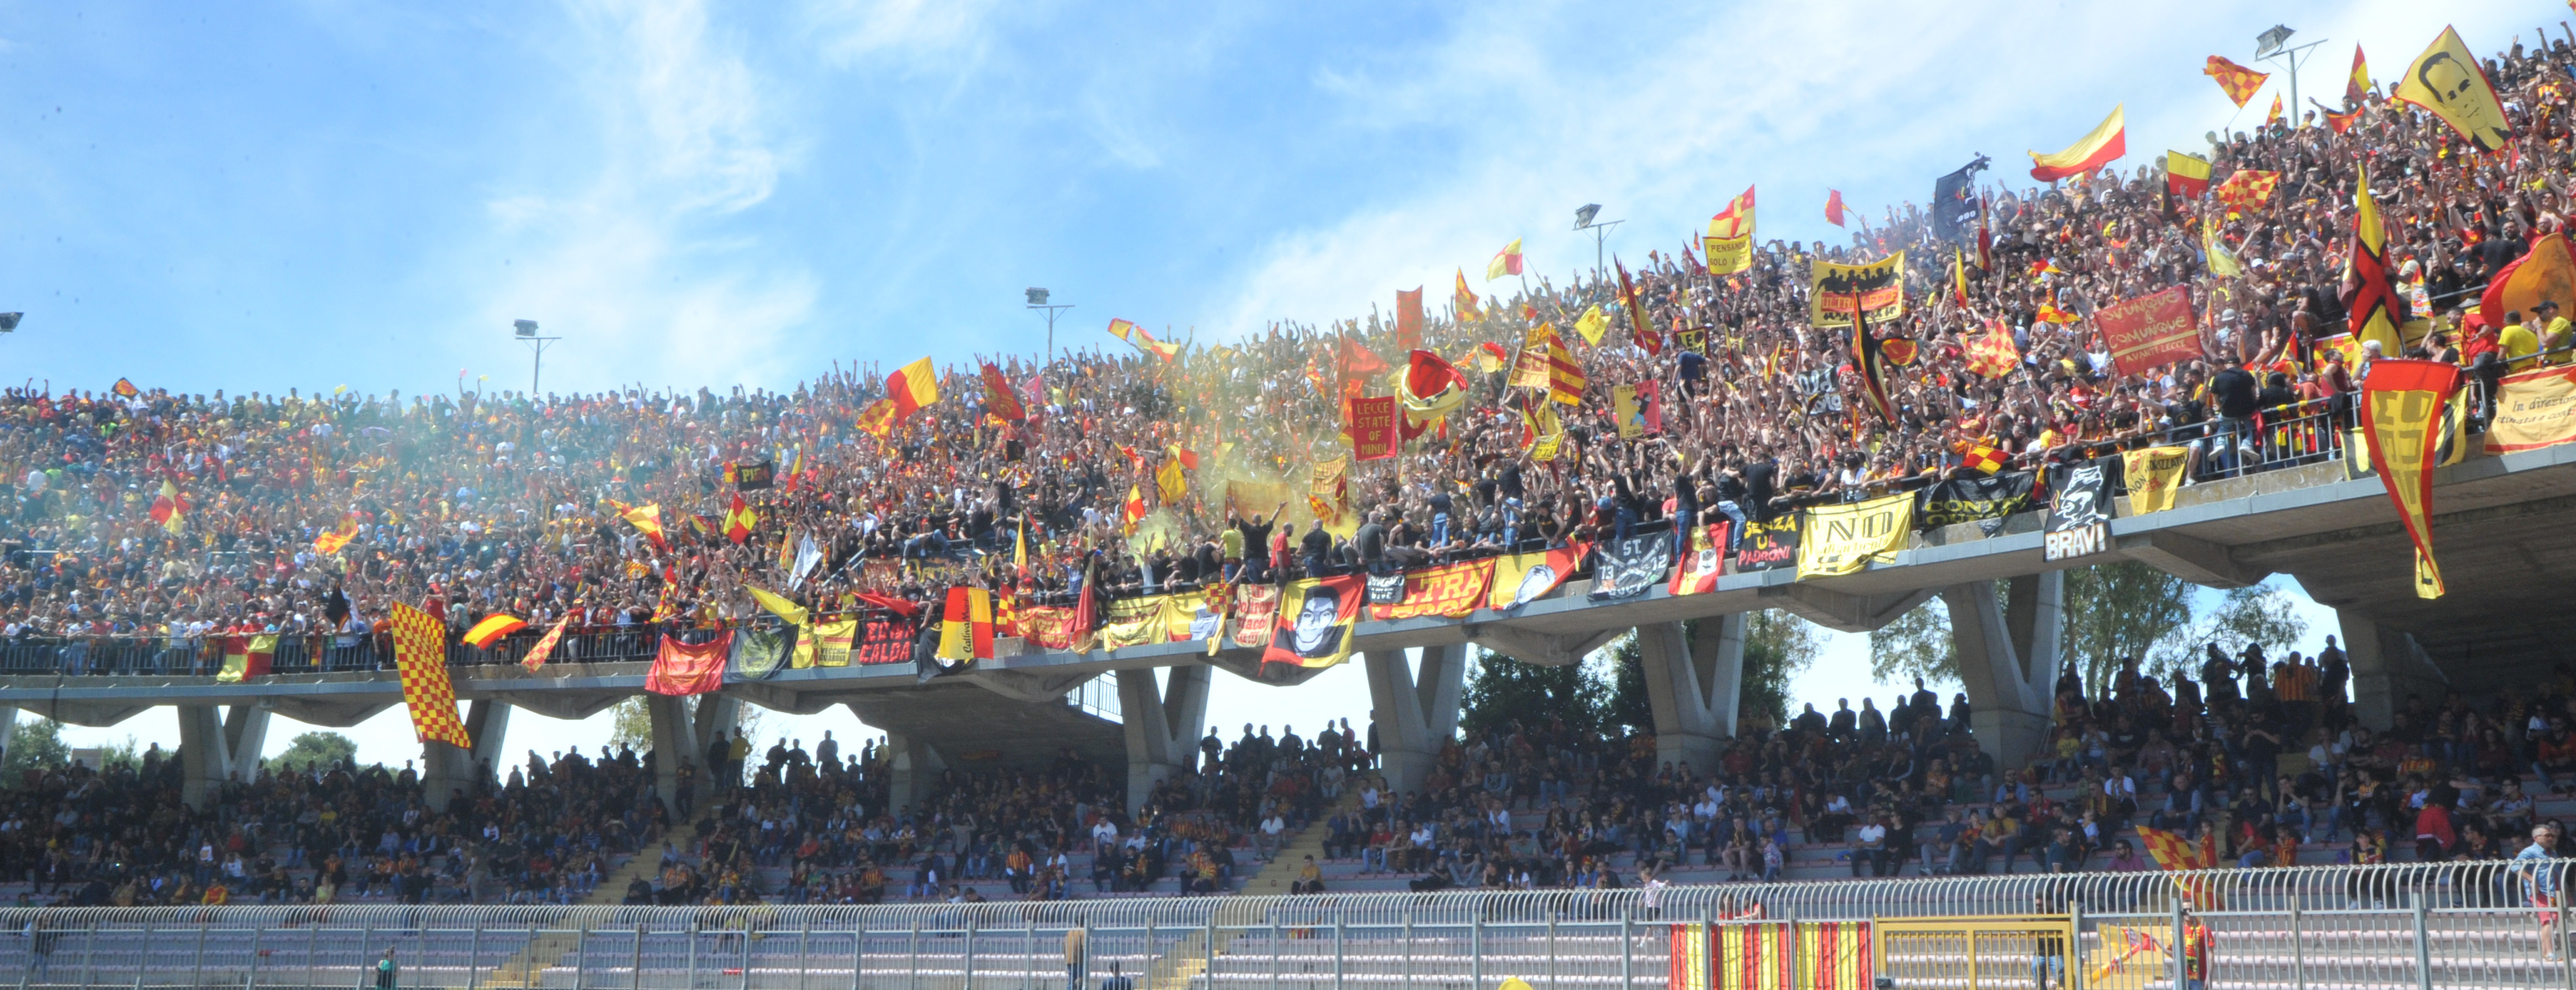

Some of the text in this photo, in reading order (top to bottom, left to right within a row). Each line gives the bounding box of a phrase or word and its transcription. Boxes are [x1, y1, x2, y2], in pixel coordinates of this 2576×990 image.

[2100, 290, 2179, 321] OVUNQUE
[2108, 315, 2188, 349] COMUNQUE
[2125, 339, 2186, 363] AVANTI LECCE
[1357, 402, 1390, 415] LECCE
[2512, 394, 2576, 412] In direzion
[1358, 415, 1391, 428] STATE
[1369, 430, 1381, 441] OF
[2128, 474, 2146, 496] NON
[1744, 514, 1797, 539] SENZA
[1826, 511, 1894, 543] NO
[1738, 545, 1791, 567] PADRONI
[1403, 567, 1487, 606] LTRA
[863, 621, 916, 642] ZONA
[858, 641, 911, 663] CALDA
